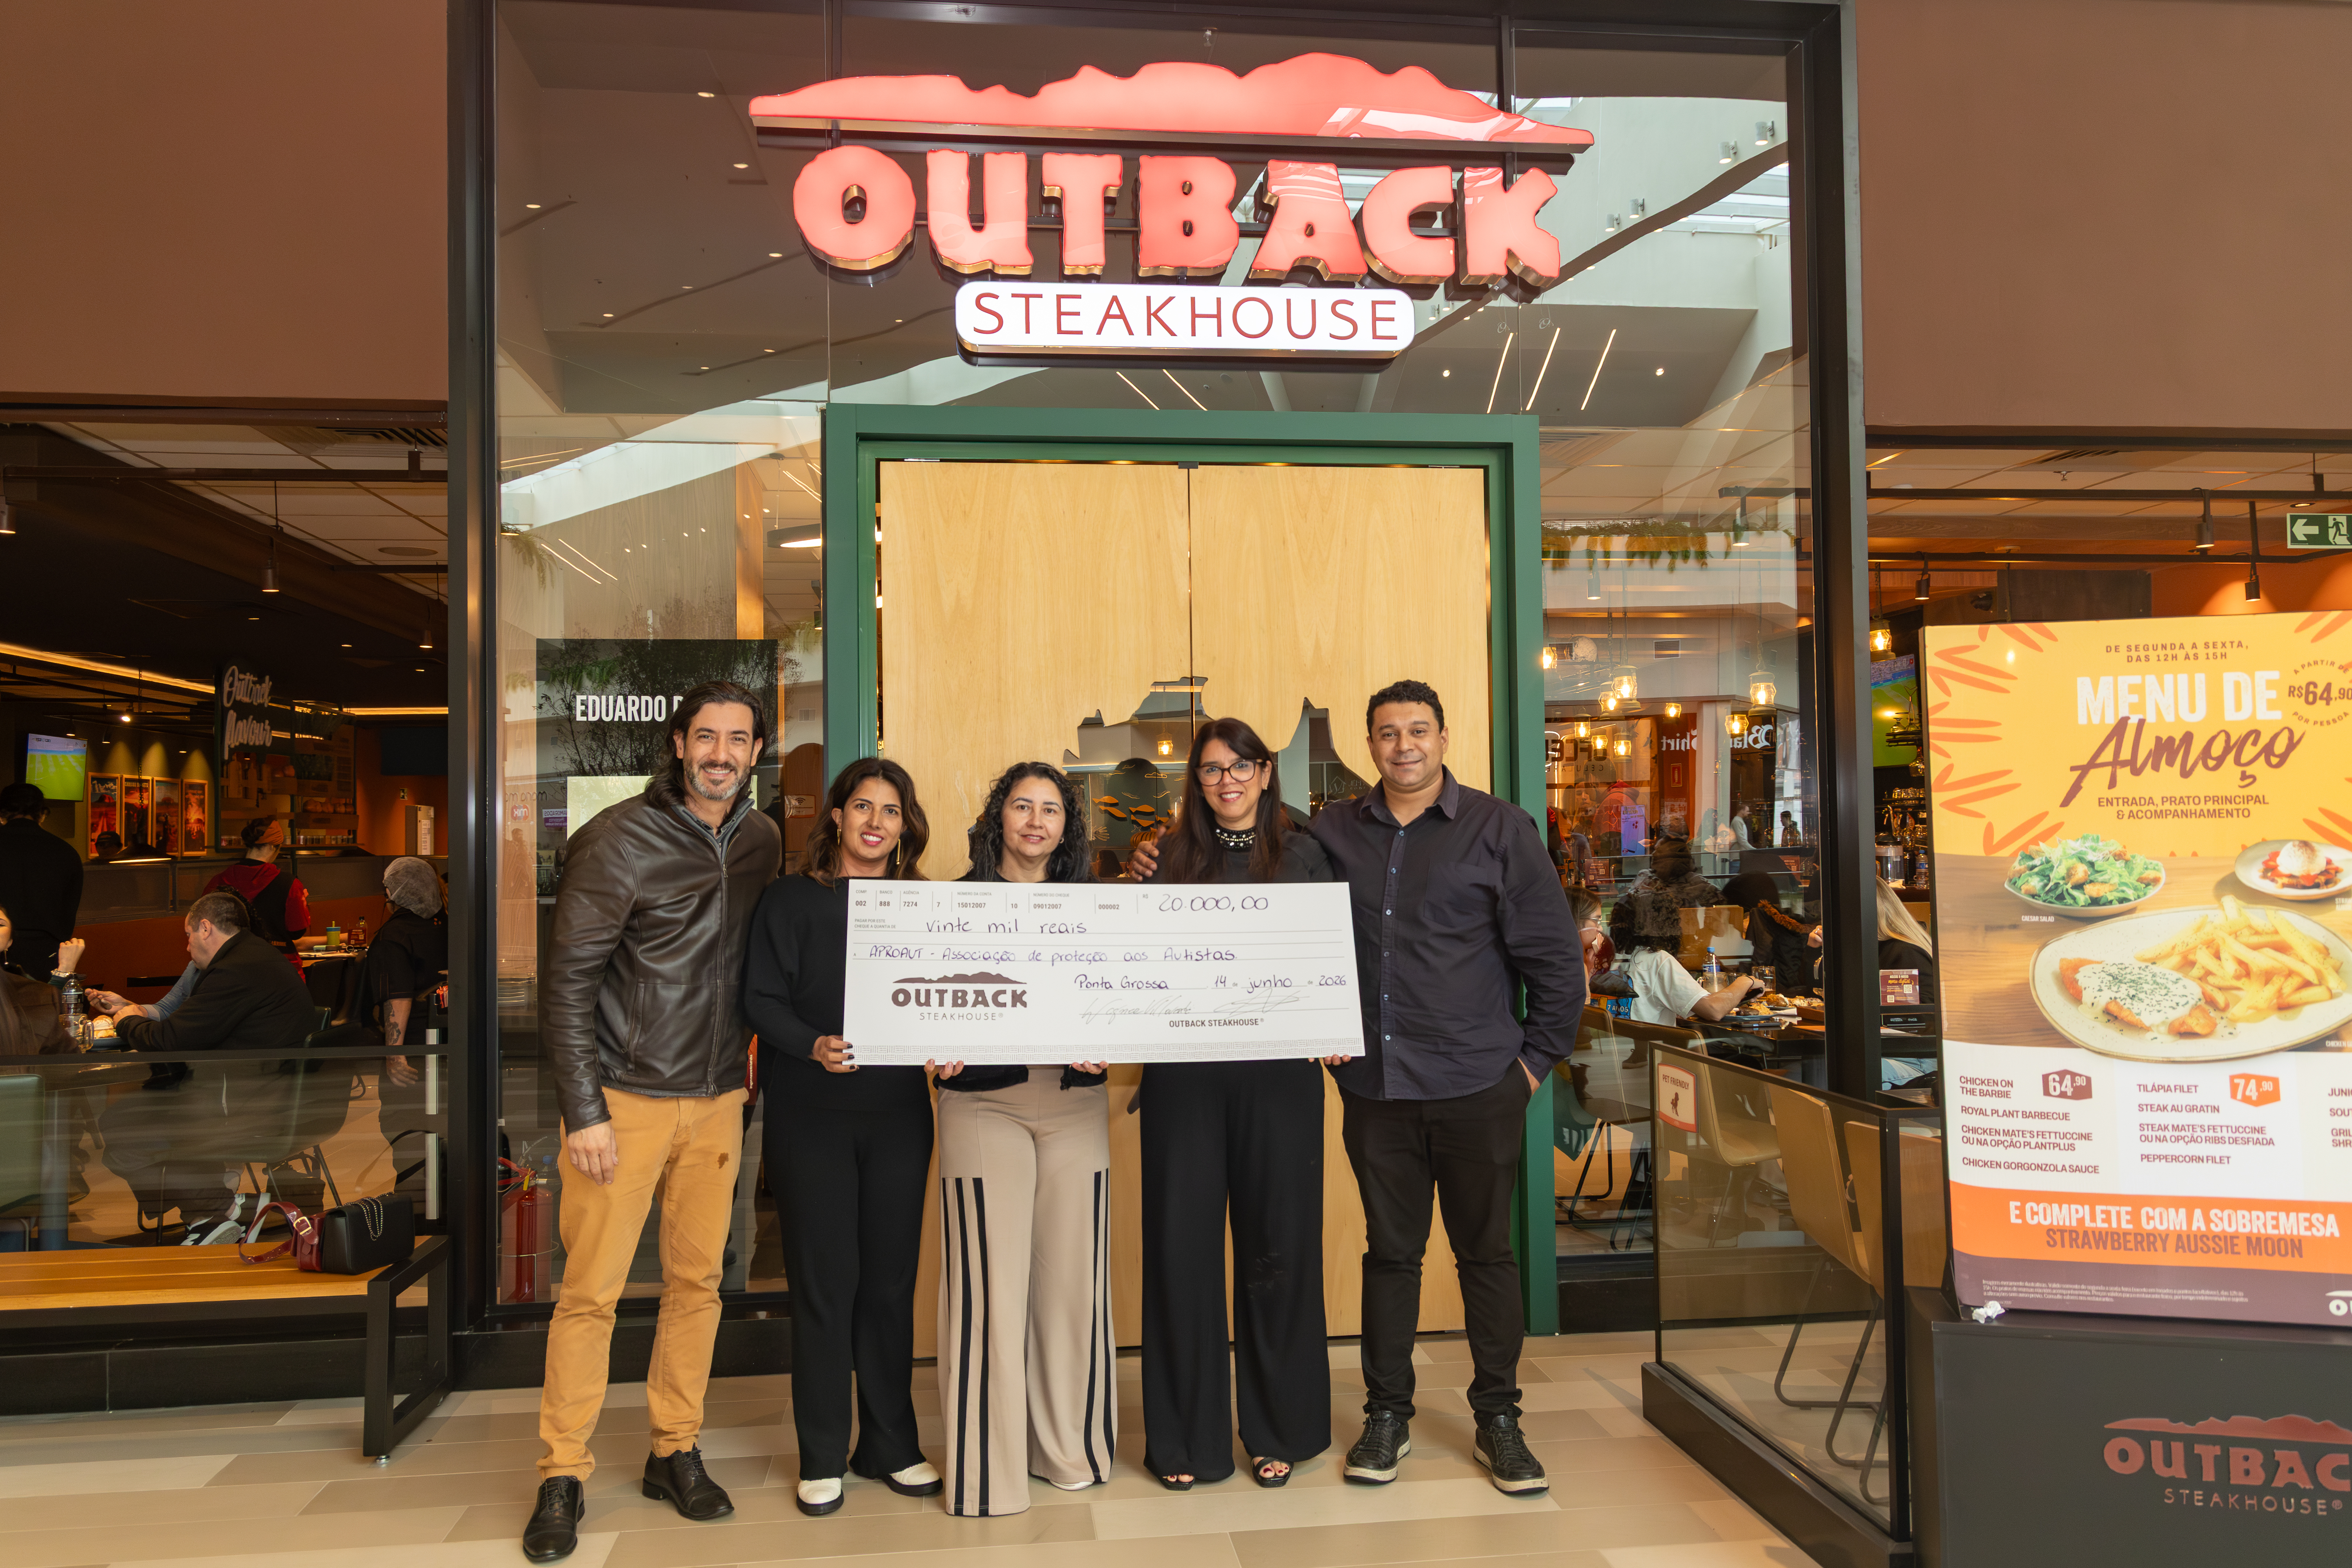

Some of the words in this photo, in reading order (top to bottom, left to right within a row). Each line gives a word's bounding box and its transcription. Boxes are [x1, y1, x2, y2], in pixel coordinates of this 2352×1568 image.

[793, 145, 1560, 283] OUTBACK
[973, 291, 1398, 342] STEAKHOUSE
[2105, 645, 2122, 653] DE
[2126, 643, 2186, 652] SEGUNDA
[2191, 642, 2199, 651] A
[2204, 640, 2249, 651] SEXTA,
[2126, 654, 2151, 663] DAS
[2156, 653, 2178, 662] 12H
[2184, 651, 2199, 661] ÀS
[2204, 652, 2228, 660] 15H
[2301, 660, 2335, 670] PARTIR
[2338, 664, 2349, 674] DE
[2076, 673, 2207, 725] MENU
[2223, 670, 2282, 721] DE
[576, 695, 666, 722] EDUARDO
[2293, 711, 2310, 724] POR
[2313, 711, 2349, 726] PESSOA
[2059, 715, 2306, 808] Almoço
[2098, 796, 2159, 809] ENTRADA,
[2161, 795, 2201, 807] PRATO
[2204, 794, 2269, 806] PRINCIPAL
[2116, 809, 2125, 820] &
[2127, 808, 2250, 820] ACOMPANHAMENTO
[988, 919, 1018, 933] mil
[1040, 921, 1086, 934] reais
[943, 948, 1016, 964] Associação
[1028, 950, 1042, 961] de
[1052, 951, 1107, 967] proteção
[1124, 952, 1148, 961] aos
[1075, 974, 1113, 989] Ponta
[1121, 976, 1169, 989] Grossa
[1214, 975, 1226, 987] 14
[1247, 975, 1292, 993] junho
[1319, 975, 1346, 986] 2026
[892, 988, 1027, 1008] OUTBACK
[1670, 1077, 1689, 1090] FRIENDLY
[1960, 1076, 1999, 1088] CHICKEN
[2000, 1080, 2013, 1088] ON
[2048, 1074, 2086, 1096] 64,90
[2137, 1082, 2172, 1093] TILÁPIA
[2174, 1085, 2198, 1093] FILET
[2234, 1078, 2273, 1101] 74,90
[1960, 1086, 1977, 1096] THE
[1979, 1089, 2011, 1098] BARBIE
[2328, 1088, 2352, 1097] JUNI
[1961, 1106, 1989, 1117] ROYAL
[1991, 1109, 2020, 1118] PLANT
[2022, 1111, 2070, 1121] BARBECUE
[2138, 1104, 2169, 1112] STEAK
[2171, 1104, 2183, 1113] AU
[2185, 1105, 2220, 1113] GRATIN
[1961, 1125, 2001, 1136] CHICKEN
[2003, 1128, 2034, 1139] MATE'S
[2037, 1131, 2093, 1140] FETTUCCINE
[2139, 1123, 2170, 1132] STEAK
[2171, 1124, 2205, 1133] MATE'S
[2208, 1125, 2266, 1135] FETTUCCINE
[1962, 1136, 1975, 1145] OU
[1977, 1138, 1989, 1146] NA
[1990, 1137, 2021, 1150] OPÇÃO
[2023, 1141, 2076, 1151] PLANTPLUS
[2140, 1134, 2153, 1143] OU
[2155, 1135, 2168, 1143] NA
[2170, 1134, 2203, 1146] OPÇÃO
[2205, 1136, 2226, 1144] RIBS
[2228, 1137, 2274, 1146] DESFIADA
[1963, 1157, 2001, 1169] CHICKEN
[2004, 1161, 2067, 1172] GORGONZOLA
[2068, 1164, 2099, 1173] SAUCE
[2141, 1154, 2204, 1163] PEPPERCORN
[2206, 1155, 2231, 1164] FILET
[2009, 1201, 2022, 1224] E
[2026, 1202, 2133, 1229] COMPLETE
[2141, 1205, 2189, 1231] COM
[2192, 1208, 2206, 1232] A
[2209, 1208, 2339, 1238] SOBREMESA
[2046, 1228, 2169, 1253] STRAWBERRY
[2175, 1234, 2241, 1255] AUSSIE
[2246, 1237, 2303, 1258] MOON
[2329, 1299, 2352, 1316] O
